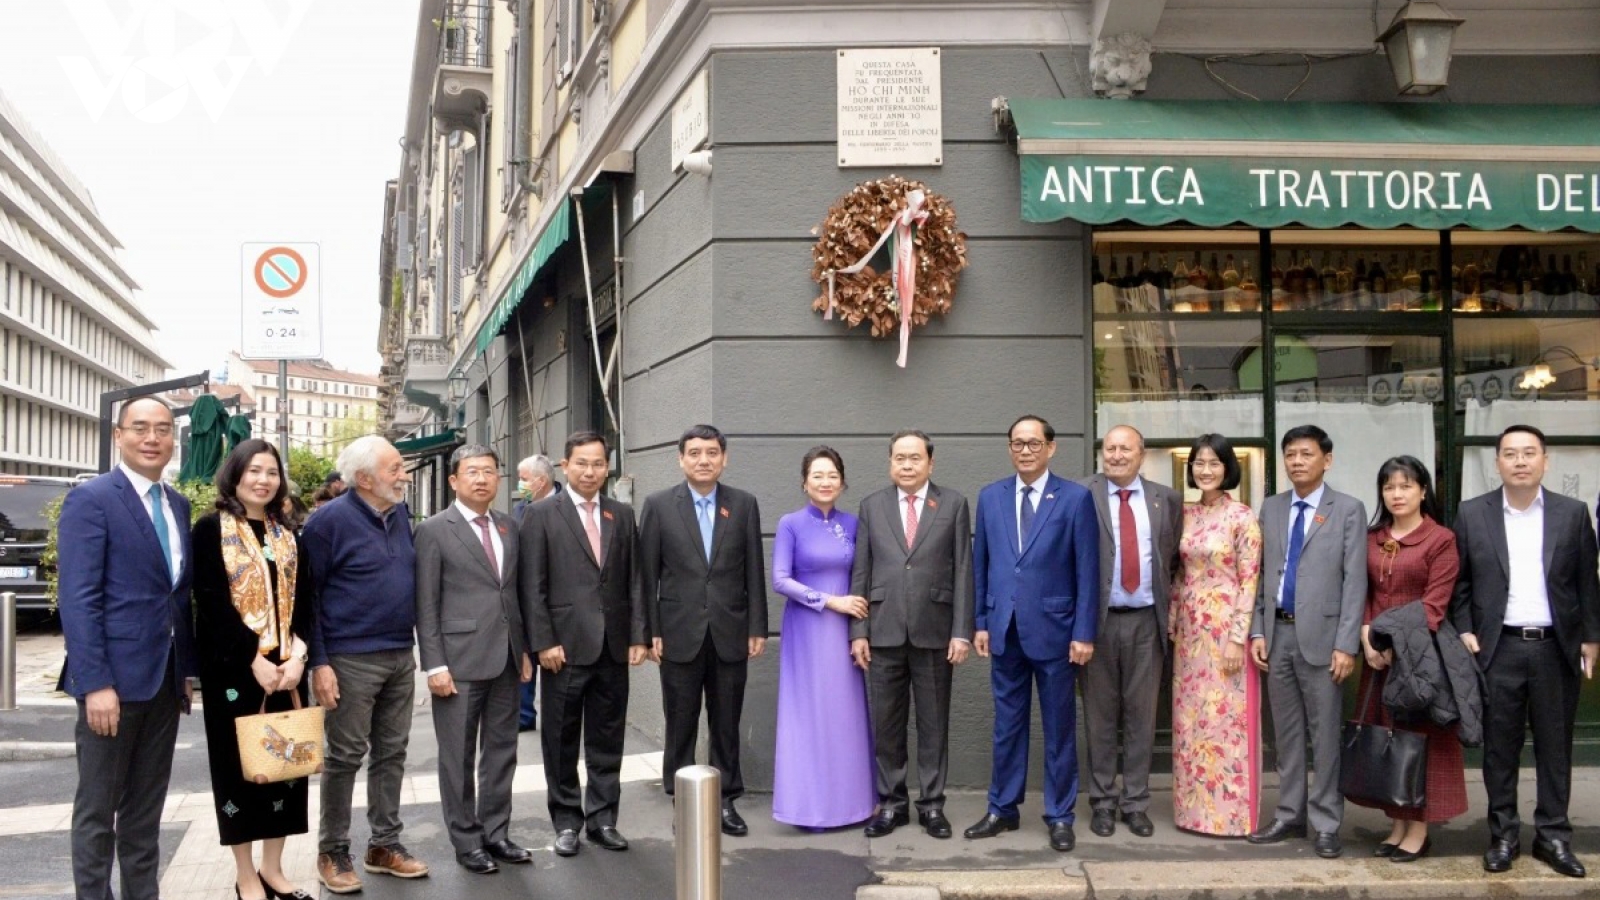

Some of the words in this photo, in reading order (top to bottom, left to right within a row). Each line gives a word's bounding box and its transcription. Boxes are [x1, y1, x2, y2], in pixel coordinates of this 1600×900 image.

[862, 61, 891, 69] QUESTA
[869, 69, 923, 77] FREQUENTATA
[848, 85, 867, 96] HO
[872, 85, 893, 95] CHI
[898, 85, 930, 95] MINH
[852, 96, 889, 104] DURANTE
[1040, 165, 1205, 206] ANTICA
[1249, 168, 1493, 212] TRATTORIA
